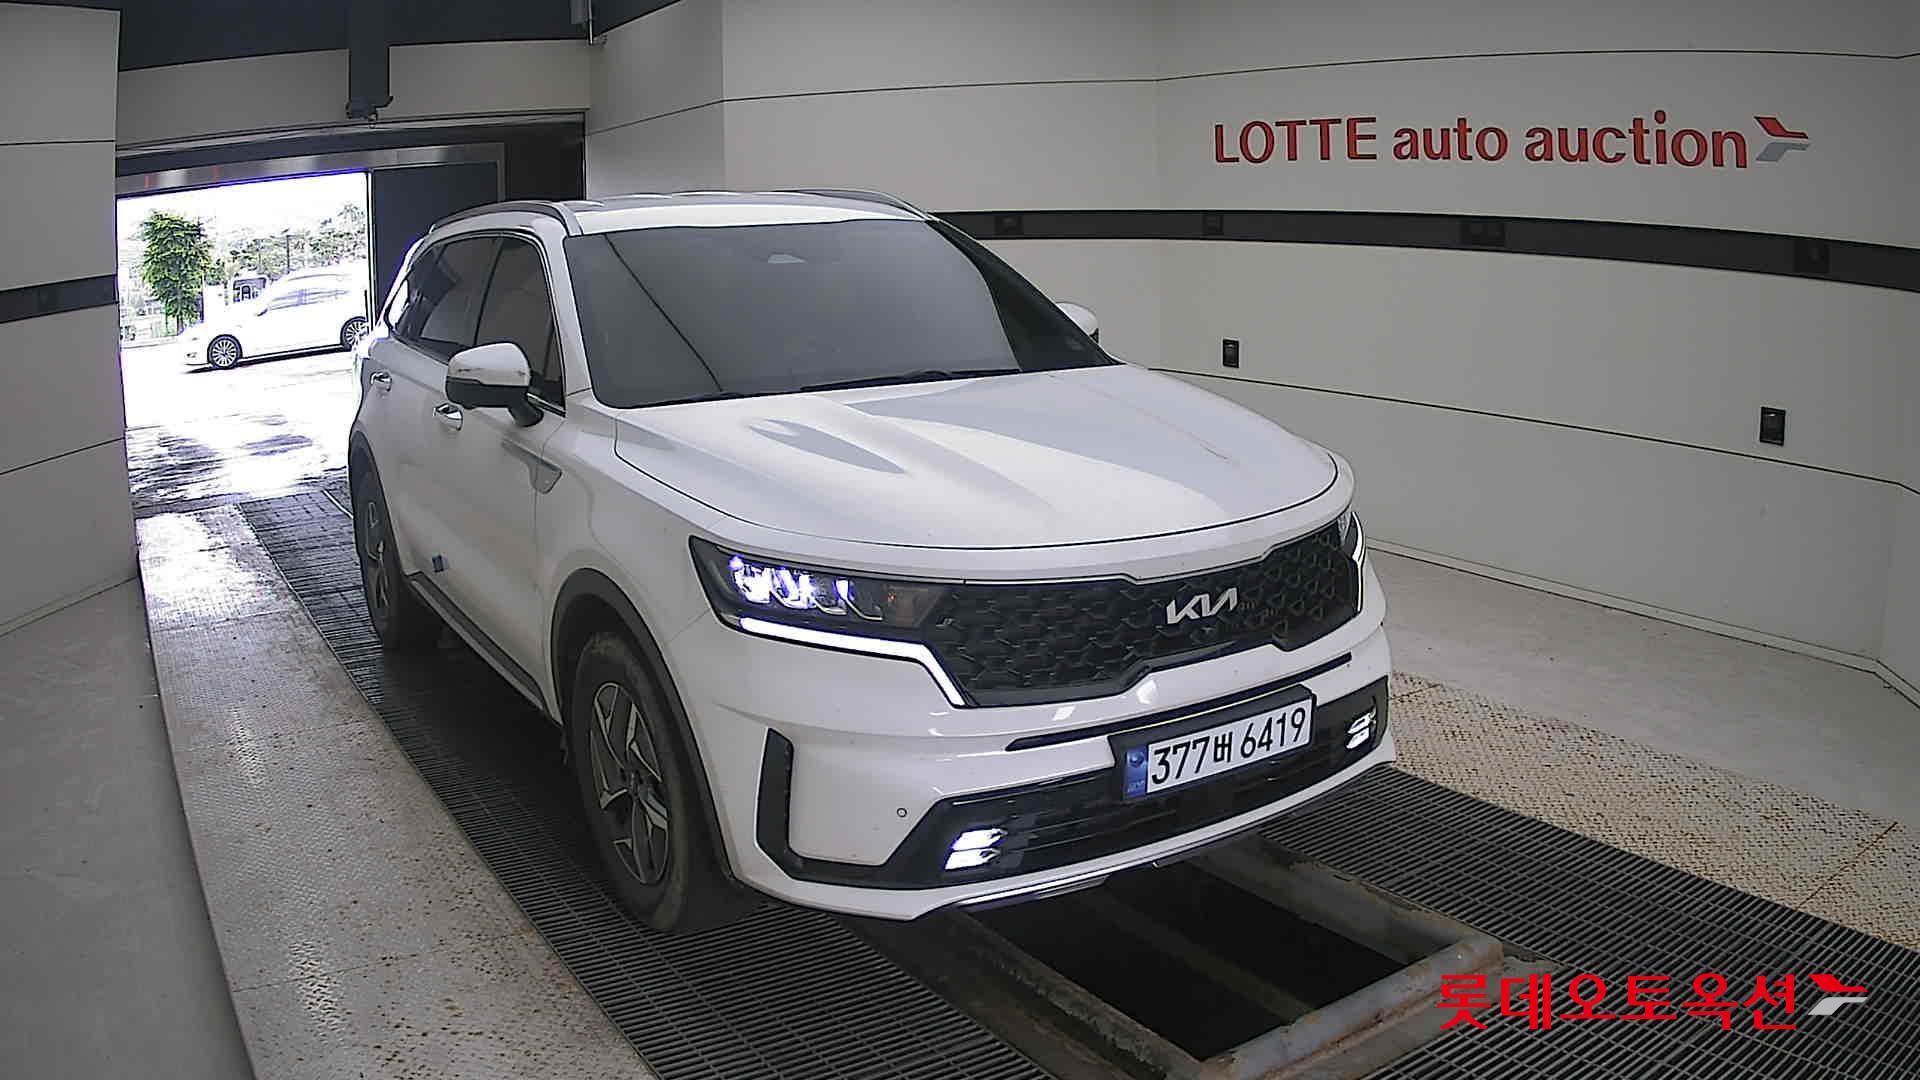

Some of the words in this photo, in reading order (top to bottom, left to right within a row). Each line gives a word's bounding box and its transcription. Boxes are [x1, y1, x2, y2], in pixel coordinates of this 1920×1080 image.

[1214, 117, 1377, 163] LOTTE
[1392, 117, 1509, 162] auto
[1524, 110, 1749, 169] auction
[1166, 587, 1238, 624] KIA
[1240, 707, 1306, 759] 6419
